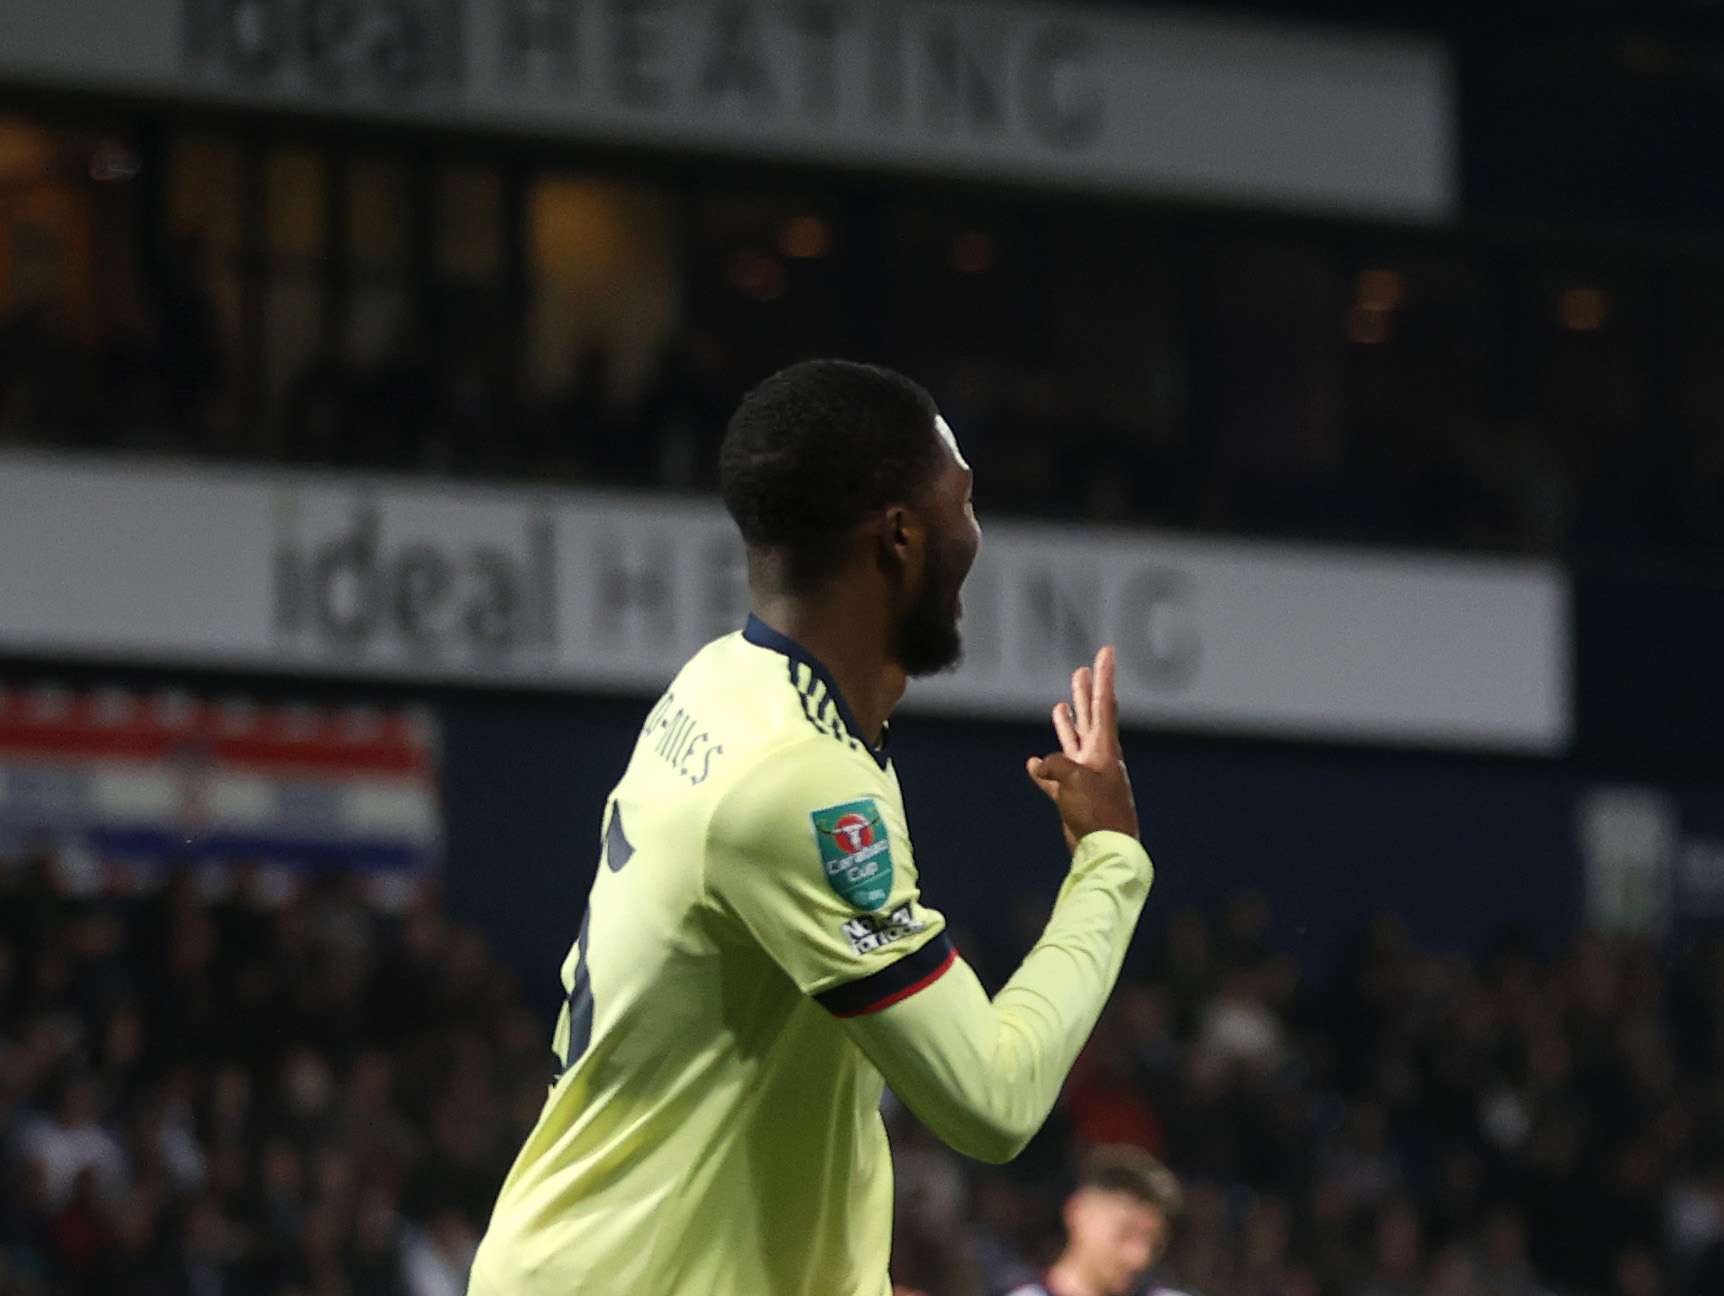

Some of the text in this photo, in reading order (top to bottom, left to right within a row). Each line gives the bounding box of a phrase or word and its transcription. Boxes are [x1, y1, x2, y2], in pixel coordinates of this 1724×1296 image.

[502, 0, 1108, 155] HEATING
[268, 484, 1202, 696] ideal HEING
